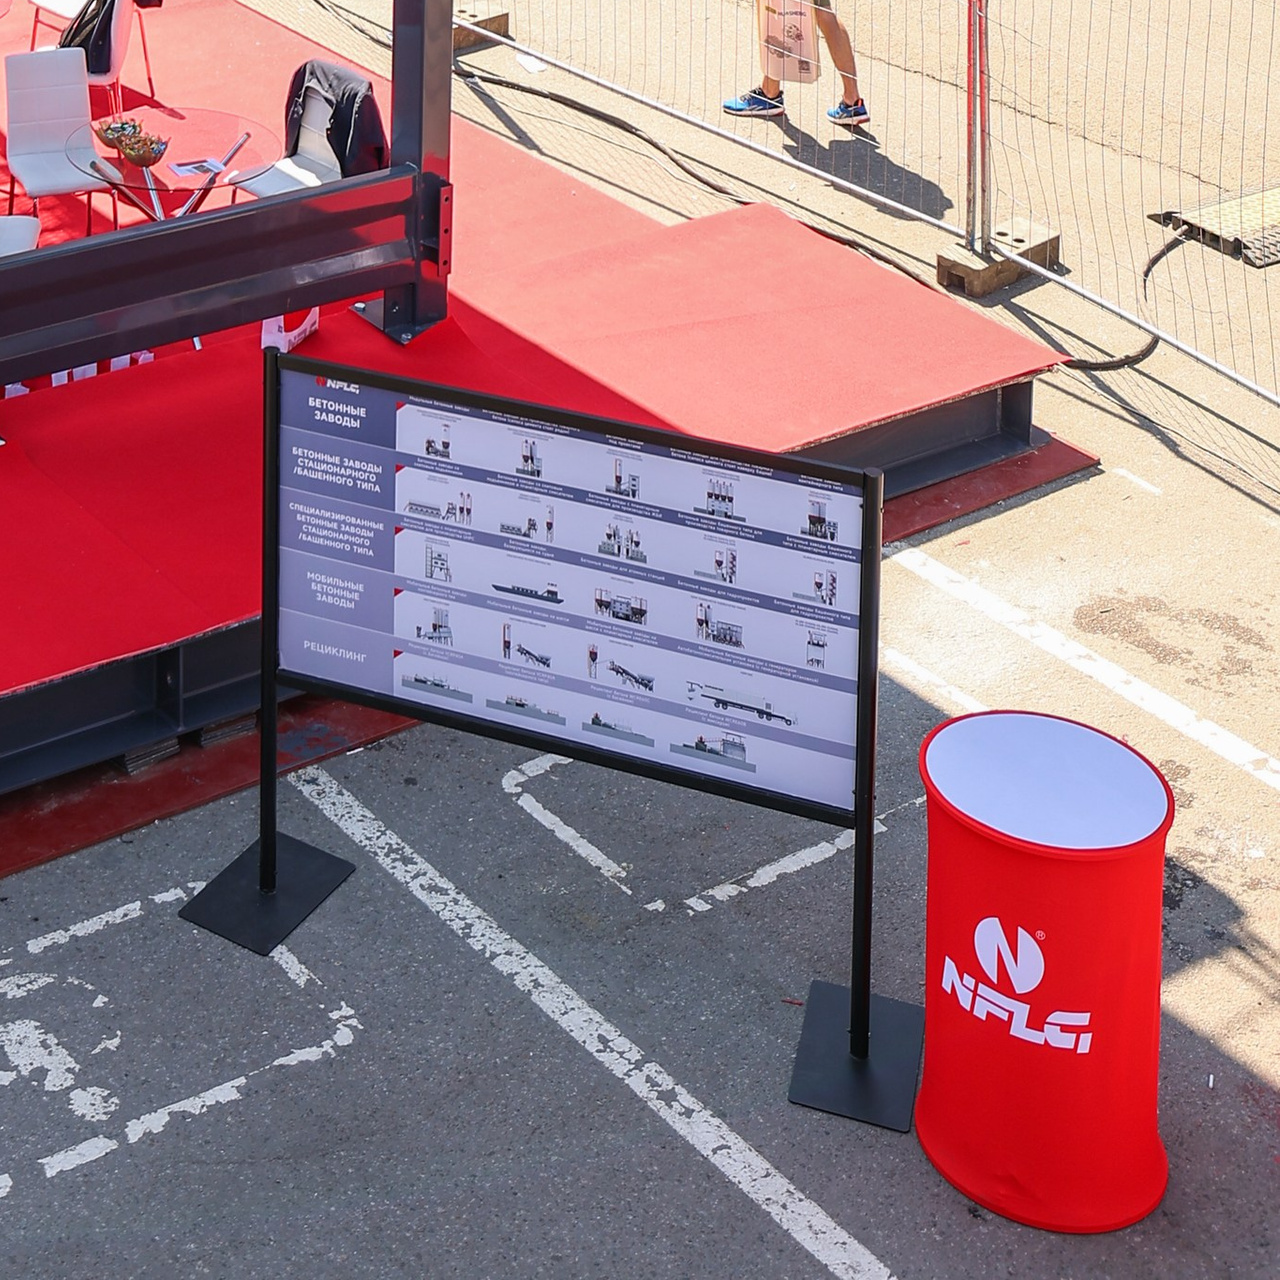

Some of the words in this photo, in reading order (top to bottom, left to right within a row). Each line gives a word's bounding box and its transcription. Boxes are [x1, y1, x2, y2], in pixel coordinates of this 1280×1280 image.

[308, 396, 367, 418] БЕТОННЫЕ
[314, 410, 360, 428] ЗАВОДЫ
[292, 446, 340, 465] БЕТОННЫЕ
[343, 457, 382, 474] ЗАВОДЫ
[297, 457, 377, 482] СТАЦИОНАРНОГО
[293, 467, 354, 487] /БАШЕННОГО
[356, 480, 381, 493] ТИПА
[289, 502, 385, 531] СПЕЦИАЛИЗИРОВАННЫЕ
[296, 514, 338, 530] БЕТОННЫЕ
[340, 523, 374, 538] ЗАВОДЫ
[298, 533, 351, 552] /БАШЕННОГО
[353, 546, 374, 557] ТИПА
[302, 524, 370, 546] СТАЦИОНАРНОГО
[307, 571, 365, 592] МОБИЛЬНЫЕ
[311, 583, 360, 601] БЕТОННЫЕ
[316, 593, 355, 609] ЗАВОДЫ
[303, 640, 367, 663] РЕЦИКЛИНГ
[941, 954, 1093, 1054] NFLG
